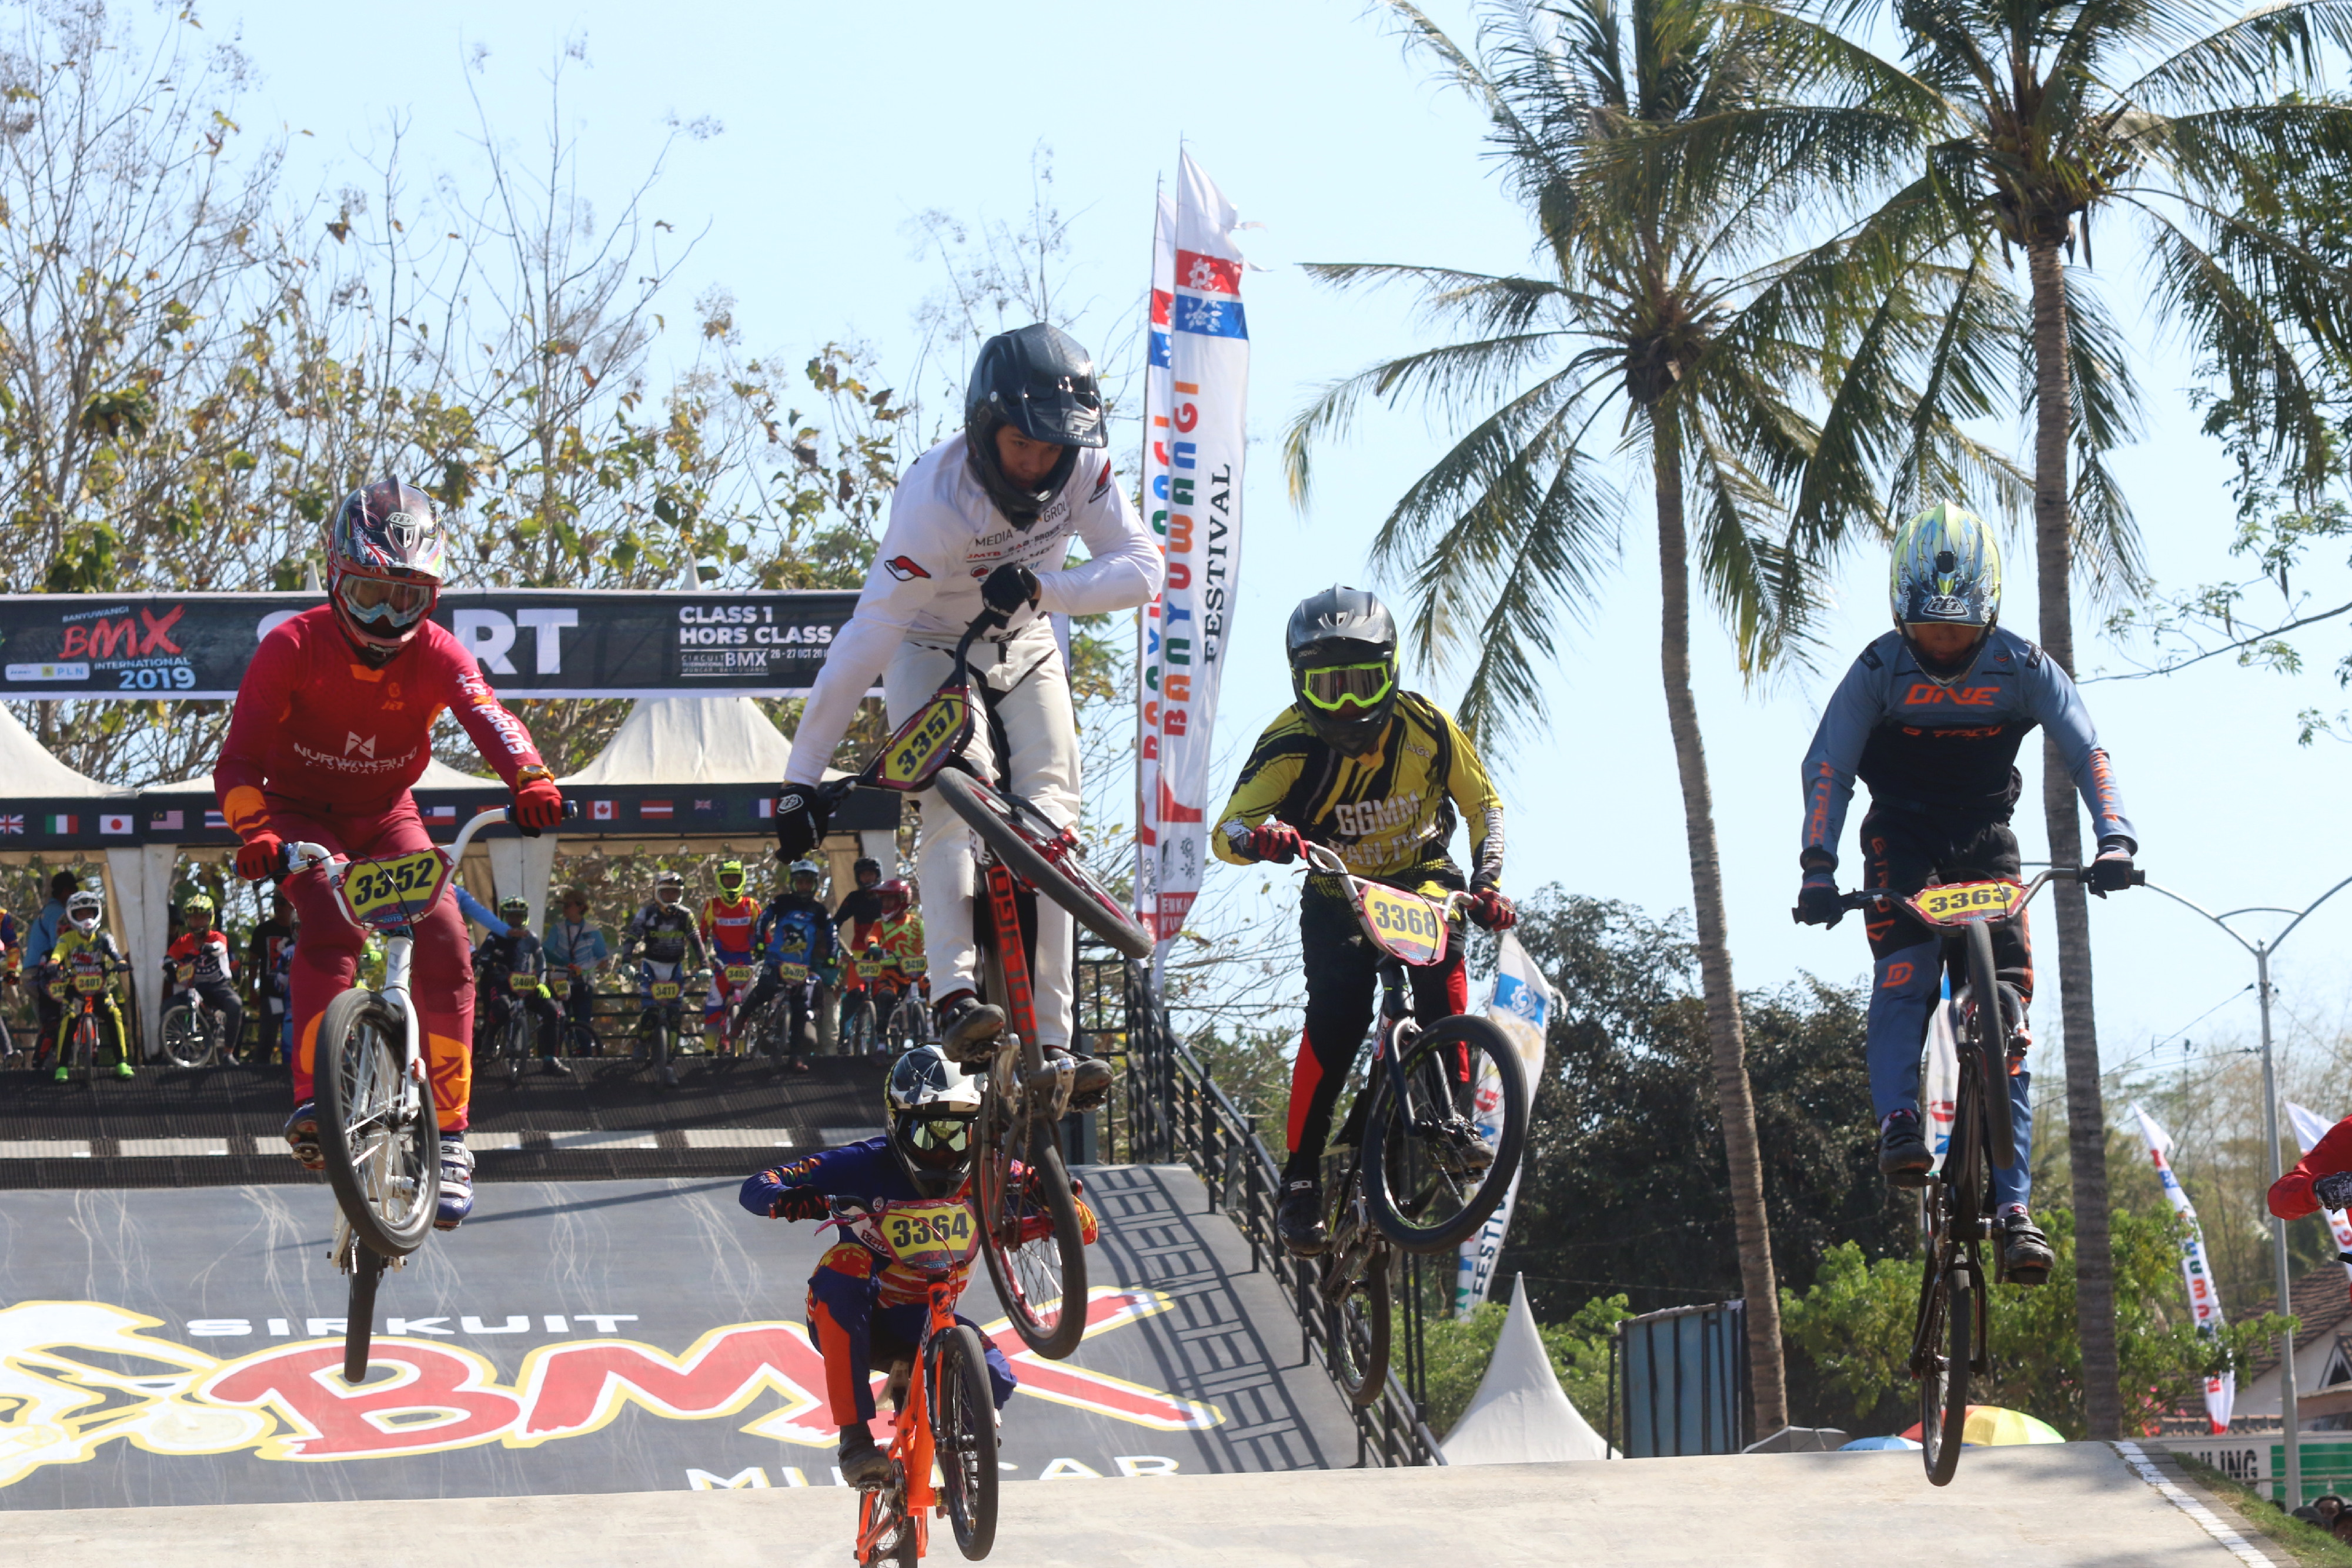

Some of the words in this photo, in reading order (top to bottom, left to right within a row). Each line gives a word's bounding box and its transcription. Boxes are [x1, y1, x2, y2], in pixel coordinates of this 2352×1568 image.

[975, 529, 1014, 547] MEDIA
[1205, 463, 1231, 664] FESTIVAL
[62, 606, 129, 623] BANYUWANGI
[679, 606, 757, 623] CLASS
[763, 606, 773, 623] 1
[58, 603, 186, 659] BMX
[680, 627, 748, 644] HORS
[754, 626, 833, 644] CLASS
[94, 657, 192, 670] INTERNATIONAL
[725, 651, 767, 667] BMX
[786, 649, 796, 658] 27
[797, 648, 811, 658] OCT
[56, 667, 83, 676] PLN
[118, 667, 196, 690] 2019
[896, 700, 957, 776] 3357
[354, 857, 435, 906] 3352
[1929, 887, 2012, 913] 3363
[383, 915, 403, 924] 2019
[1374, 901, 1437, 939] 3368
[991, 869, 1038, 1036] POLYGO
[892, 1212, 970, 1248] 3364
[186, 1315, 639, 1336] SIRKUIT
